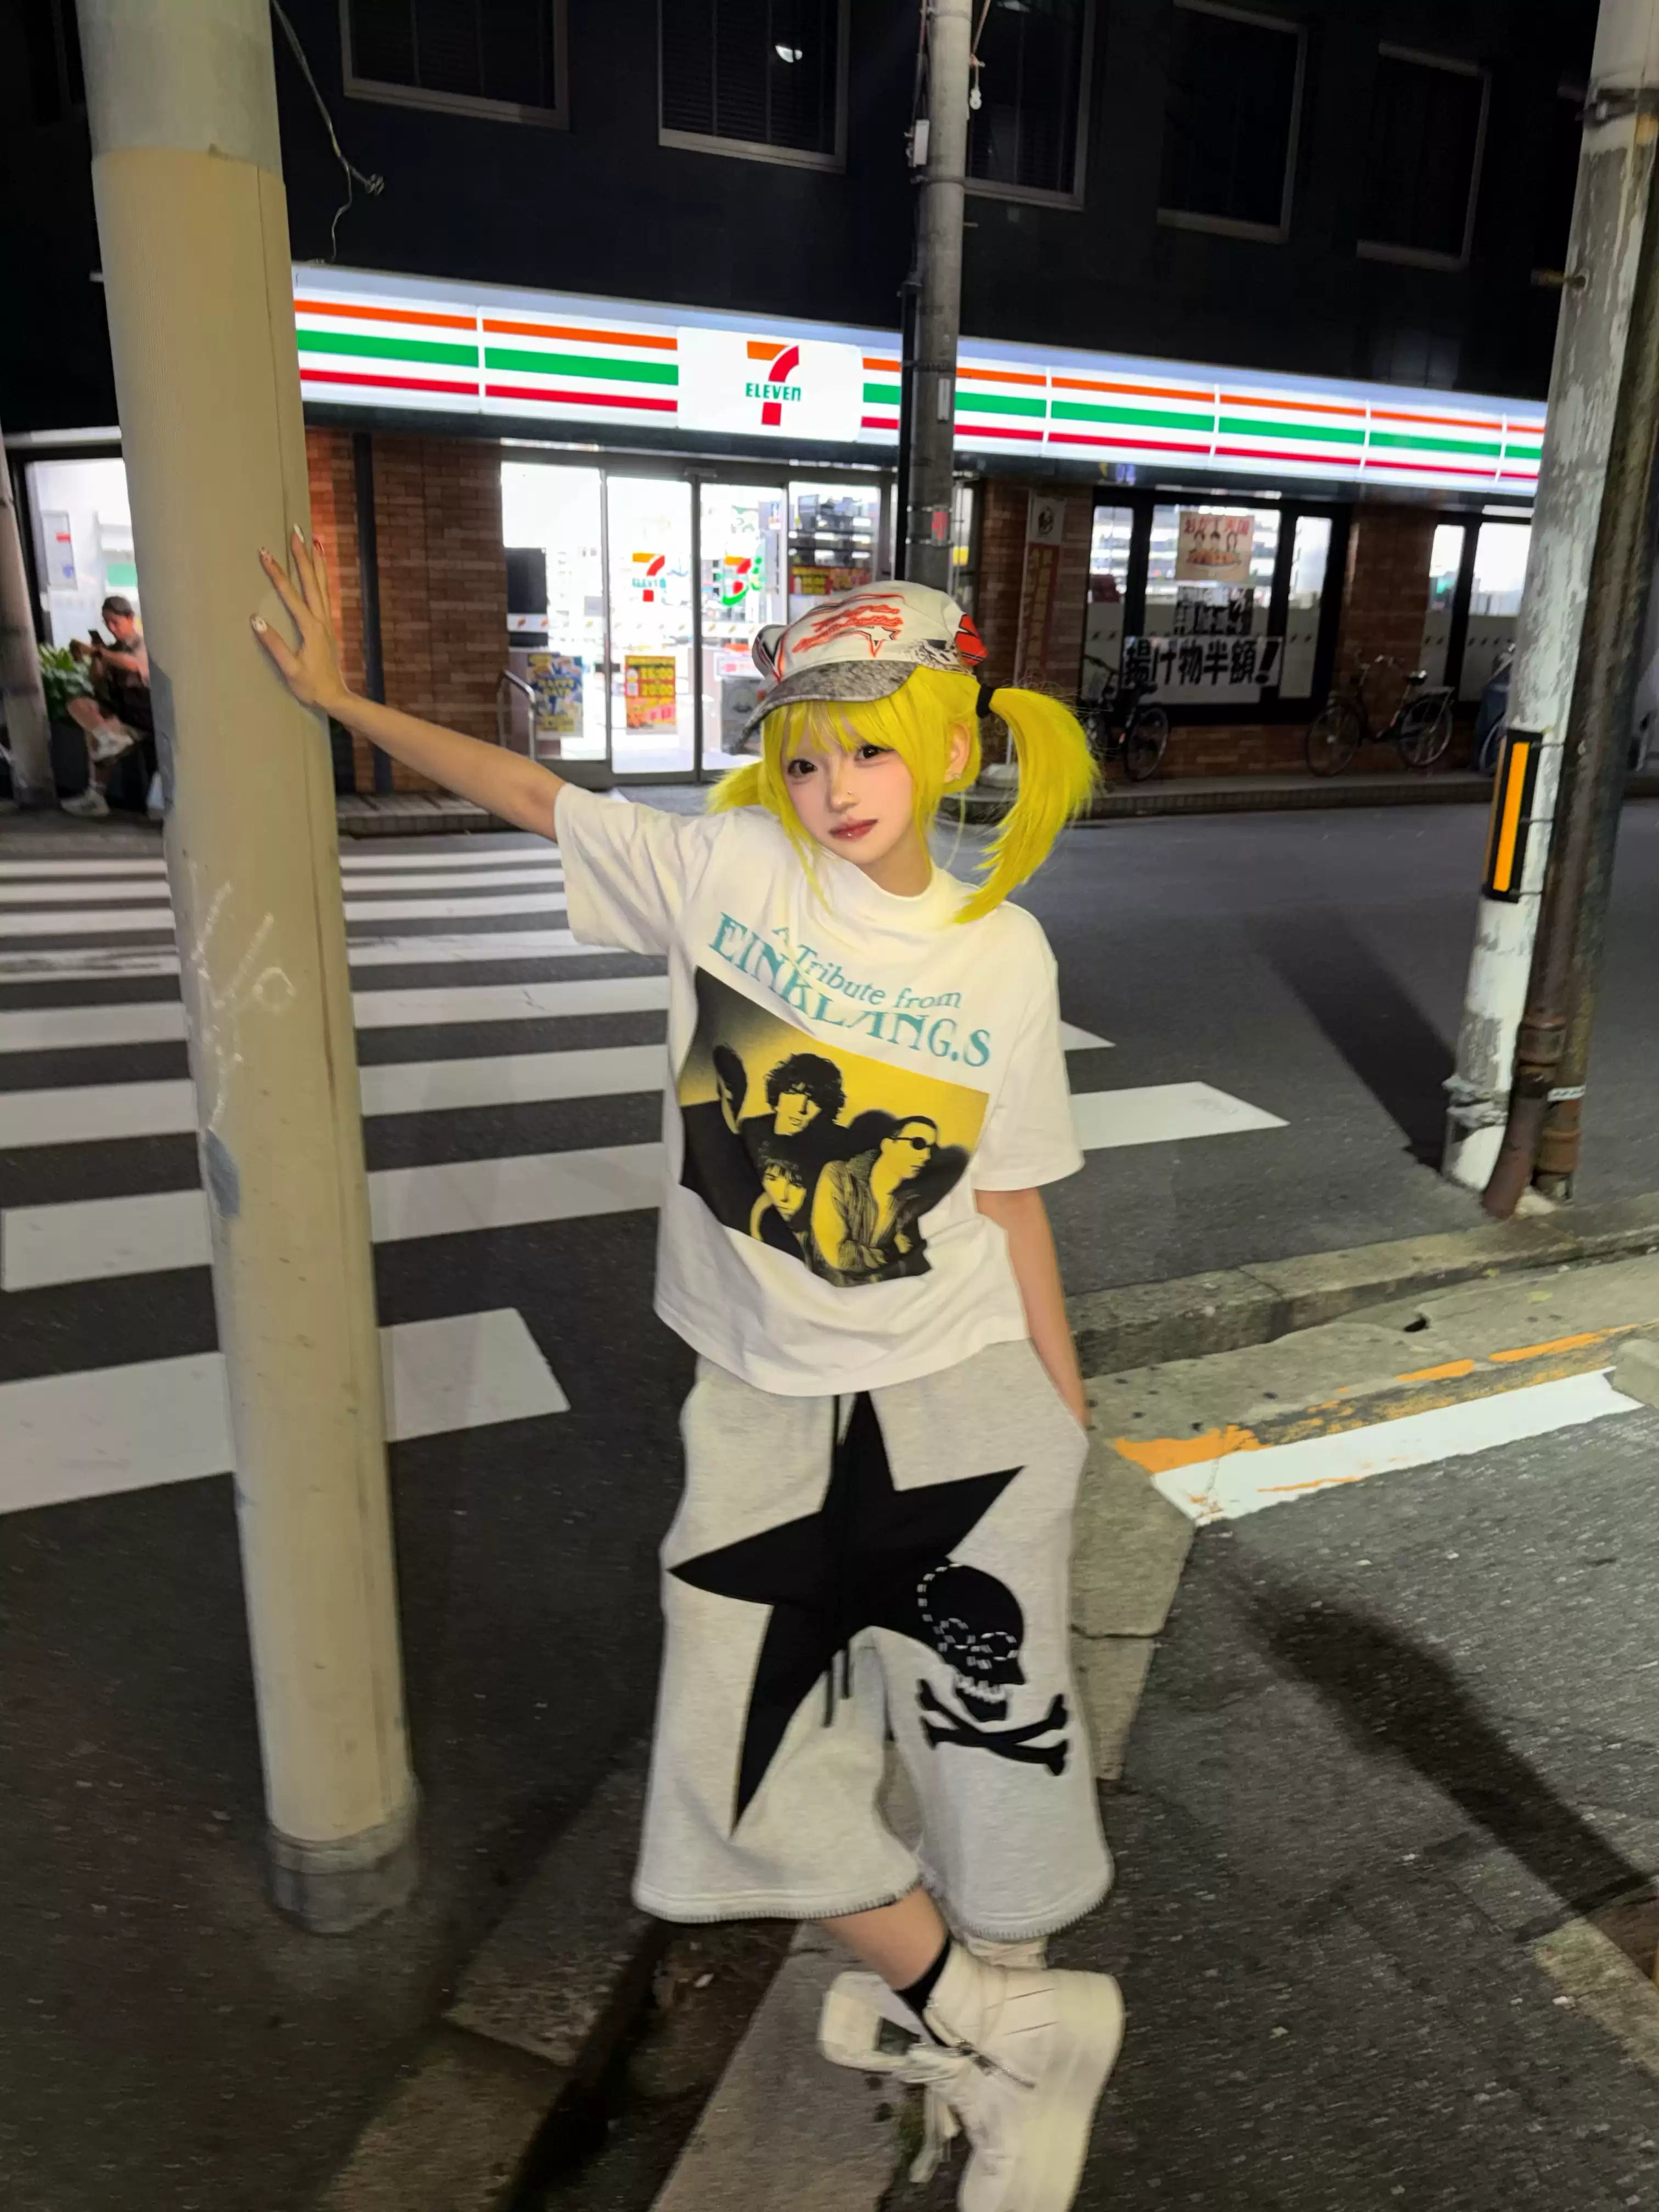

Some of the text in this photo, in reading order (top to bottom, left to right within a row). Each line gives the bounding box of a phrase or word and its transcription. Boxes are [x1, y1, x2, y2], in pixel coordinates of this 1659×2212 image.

[747, 341, 799, 426] 7
[796, 944, 885, 1005] Tribute
[891, 988, 962, 1008] from
